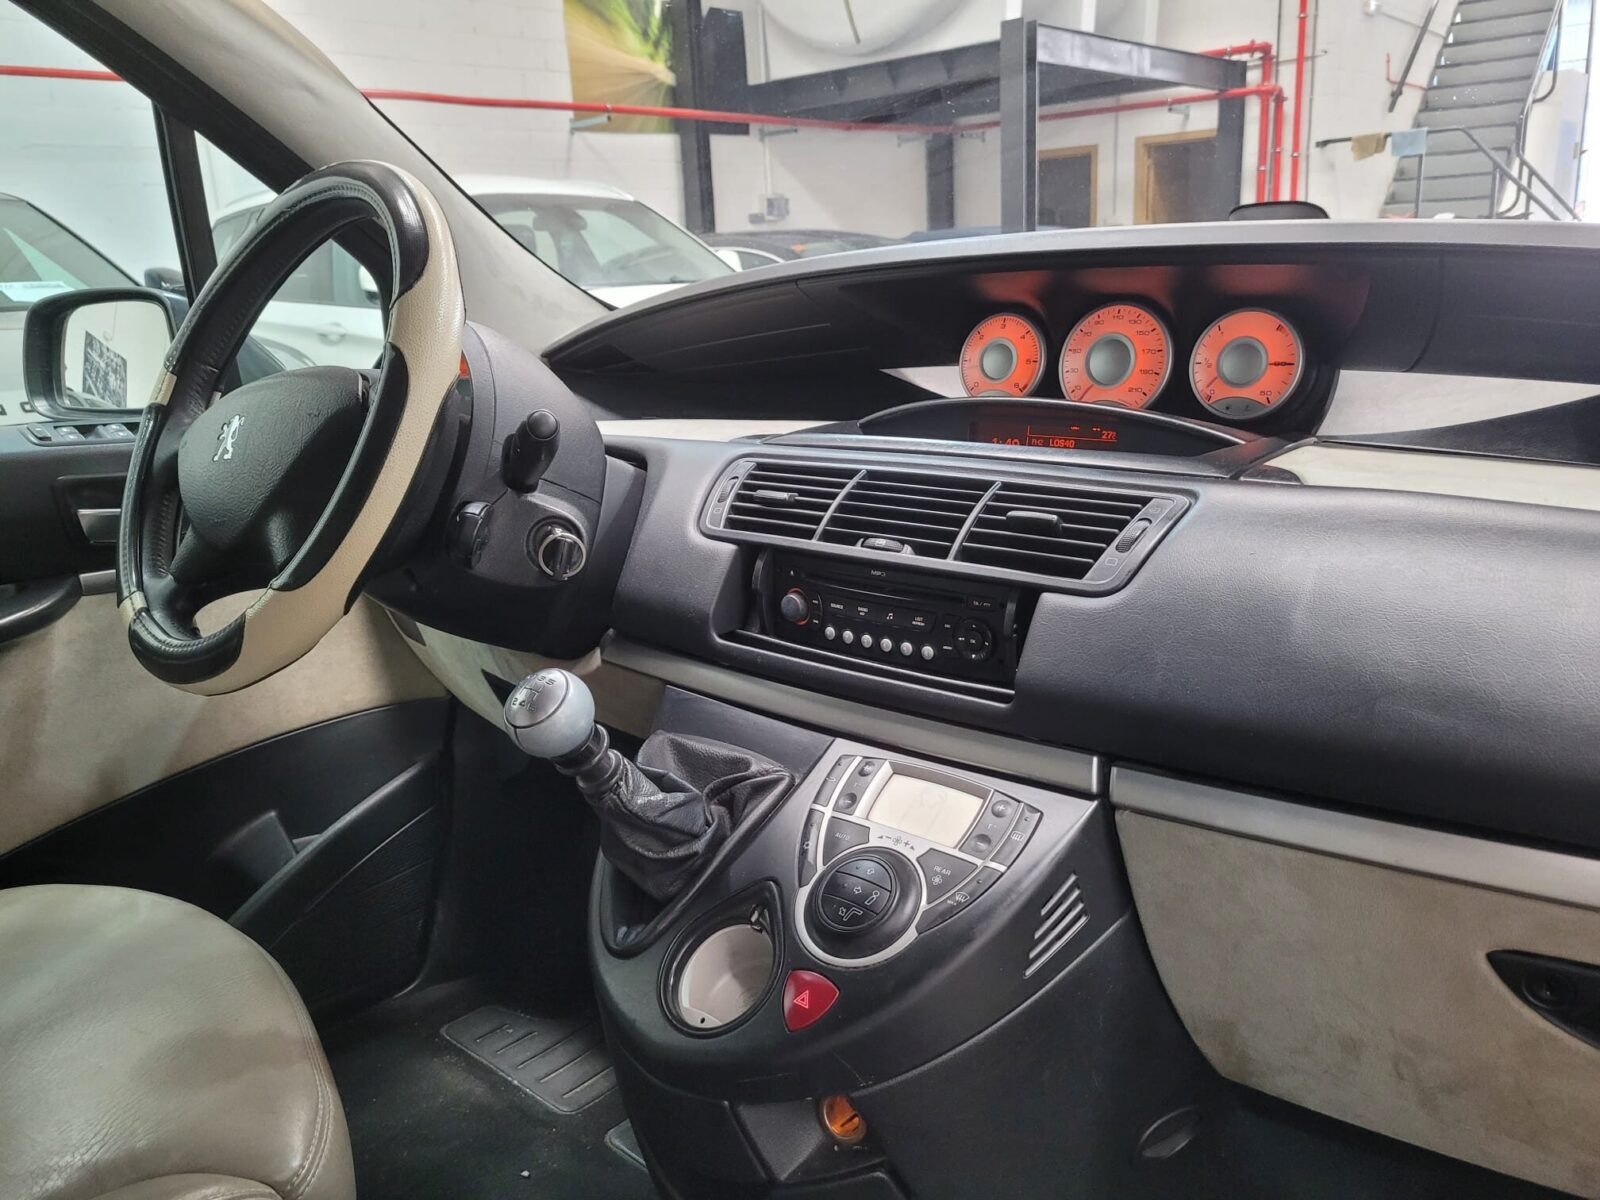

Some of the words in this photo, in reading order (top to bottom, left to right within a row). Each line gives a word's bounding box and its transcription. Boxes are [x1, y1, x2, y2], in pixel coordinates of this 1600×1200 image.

[1049, 438, 1076, 449] LOS40
[834, 831, 851, 841] AUTO
[933, 865, 952, 876] REAR
